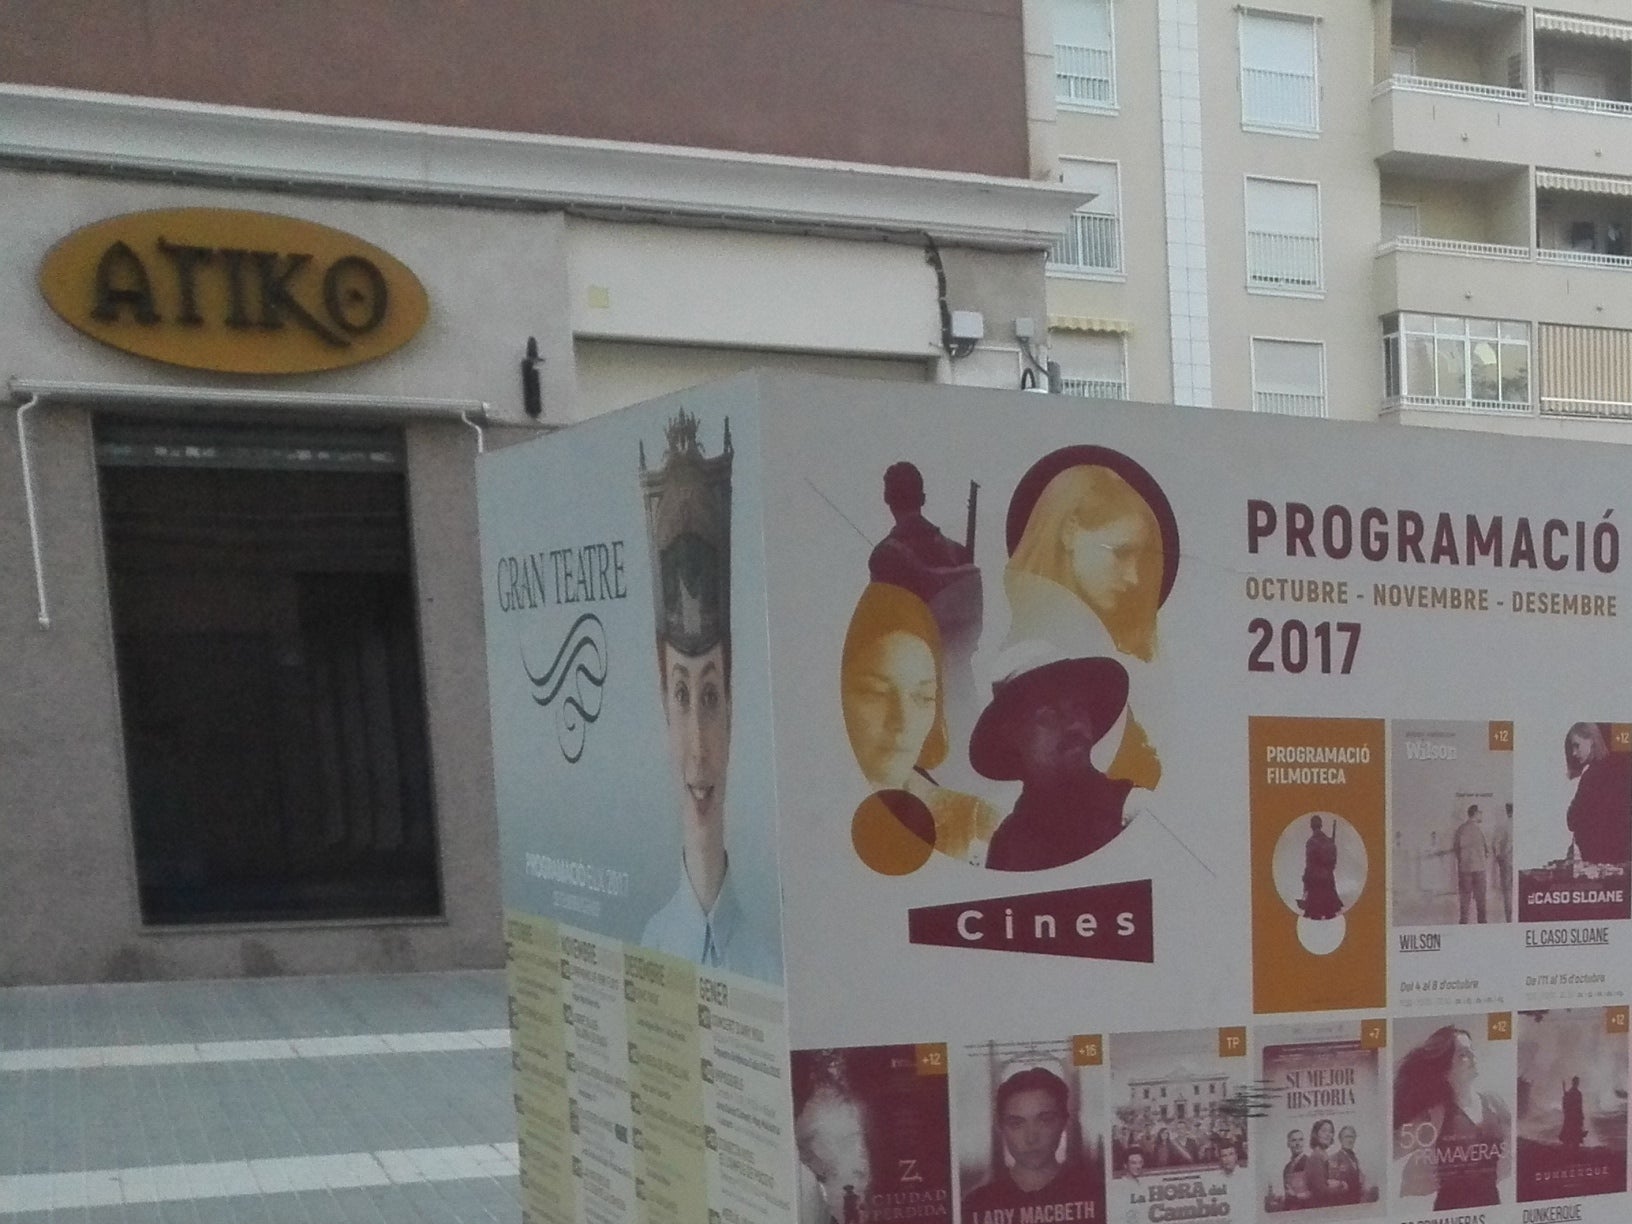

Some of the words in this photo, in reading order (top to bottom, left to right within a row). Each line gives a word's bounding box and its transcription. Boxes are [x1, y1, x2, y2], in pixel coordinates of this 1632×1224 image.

[90, 237, 389, 348] ATIKO
[1247, 499, 1620, 573] PROGRAMACIÓ
[497, 553, 546, 613] GRAN
[550, 541, 627, 605] TEATRE
[1246, 577, 1348, 604] OCTUBRE
[1373, 583, 1489, 611] NOVEMBRE
[1512, 591, 1617, 617] DESEMBRE
[1248, 617, 1362, 674] 2017
[1494, 730, 1508, 742] +12
[1616, 733, 1629, 744] +12
[1266, 744, 1370, 764] PROGRAMACIÓ
[1405, 741, 1457, 760] Wilson
[1267, 768, 1346, 785] FILMOTECA
[1535, 892, 1570, 904] CASO
[1573, 891, 1623, 903] SLOANE
[957, 908, 1136, 940] Cines
[1400, 934, 1440, 951] WILSON
[1526, 930, 1538, 945] EL
[1541, 929, 1567, 944] CASO
[1571, 927, 1608, 943] SLOANE
[1492, 1021, 1507, 1032] +12
[1611, 1014, 1625, 1026] +12
[1227, 1037, 1240, 1048] TP
[922, 1053, 941, 1066] +12
[1306, 1068, 1355, 1087] MEJOR
[1287, 1088, 1355, 1110] HISTORIA
[1402, 1122, 1438, 1150] 50
[1535, 1166, 1610, 1182] DUNKERQUE
[1148, 1182, 1207, 1202] HORA
[1149, 1197, 1231, 1223] Cambio
[1523, 1203, 1582, 1224] DUNKERQUE
